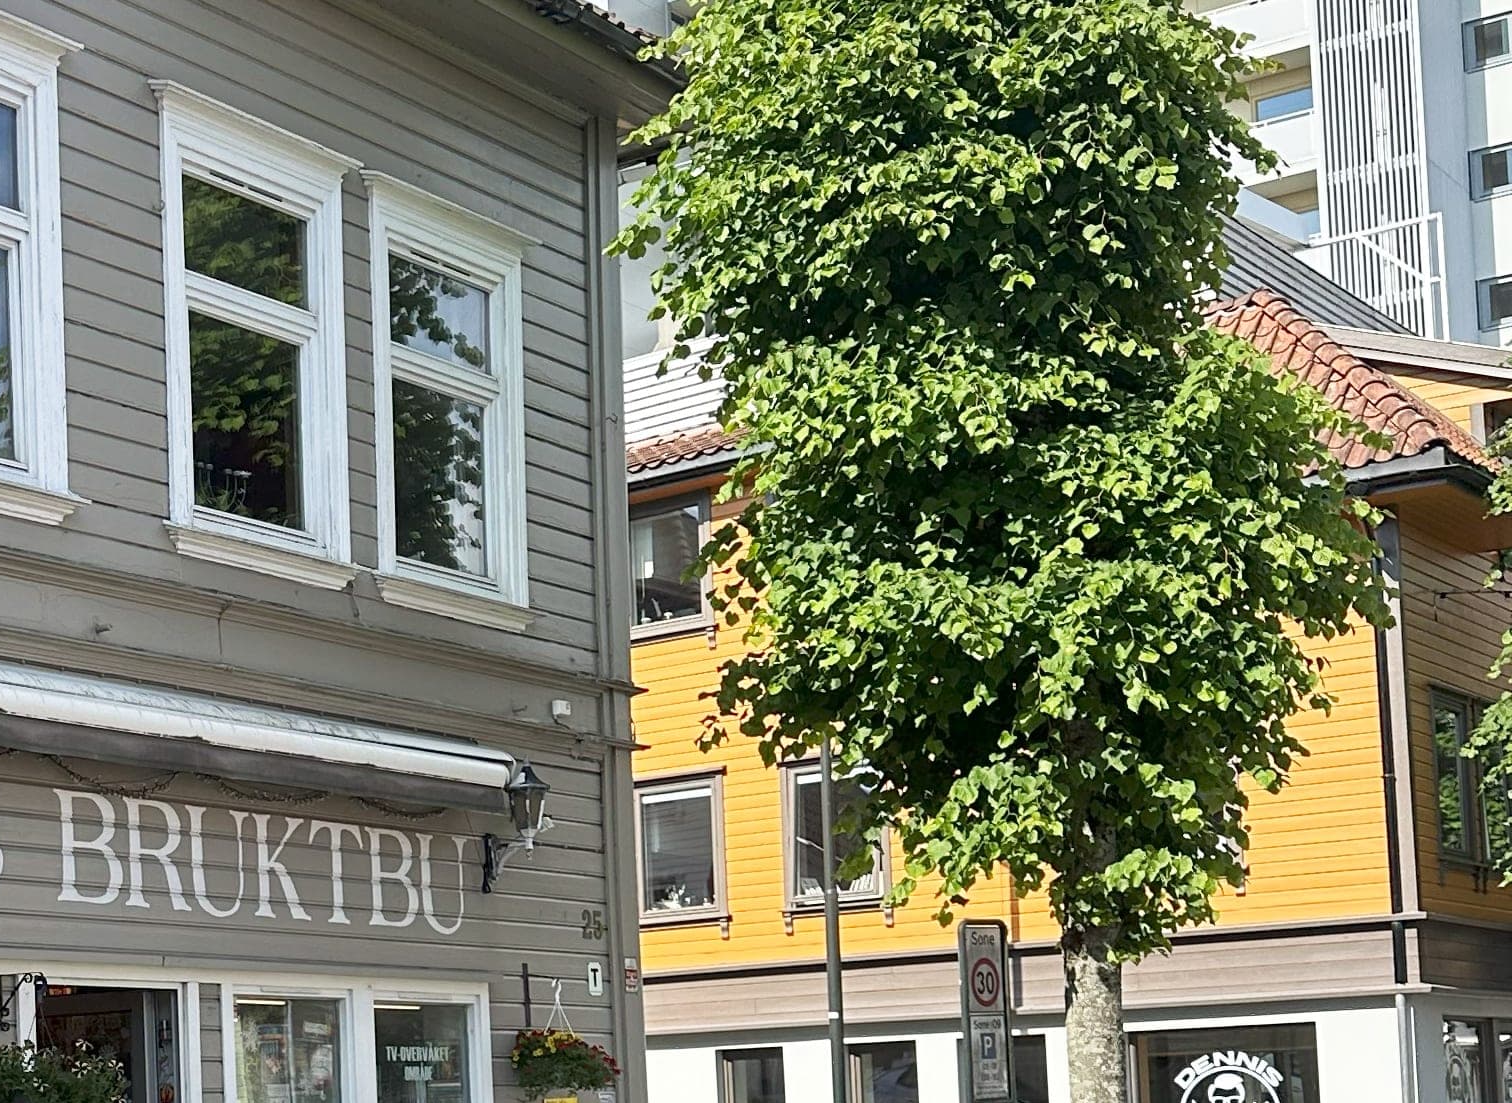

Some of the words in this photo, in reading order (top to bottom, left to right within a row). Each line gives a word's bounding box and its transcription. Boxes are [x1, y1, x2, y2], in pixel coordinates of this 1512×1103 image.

[53, 786, 469, 936] BRUKTBU
[581, 909, 603, 940] 25
[971, 932, 995, 946] Sone
[590, 968, 599, 988] T
[975, 971, 995, 996] 30
[385, 1041, 449, 1062] TV-OVERVÅKET
[983, 1036, 994, 1057] P
[404, 1061, 434, 1081] OMRÅDE
[1174, 1050, 1284, 1090] DENNIS
